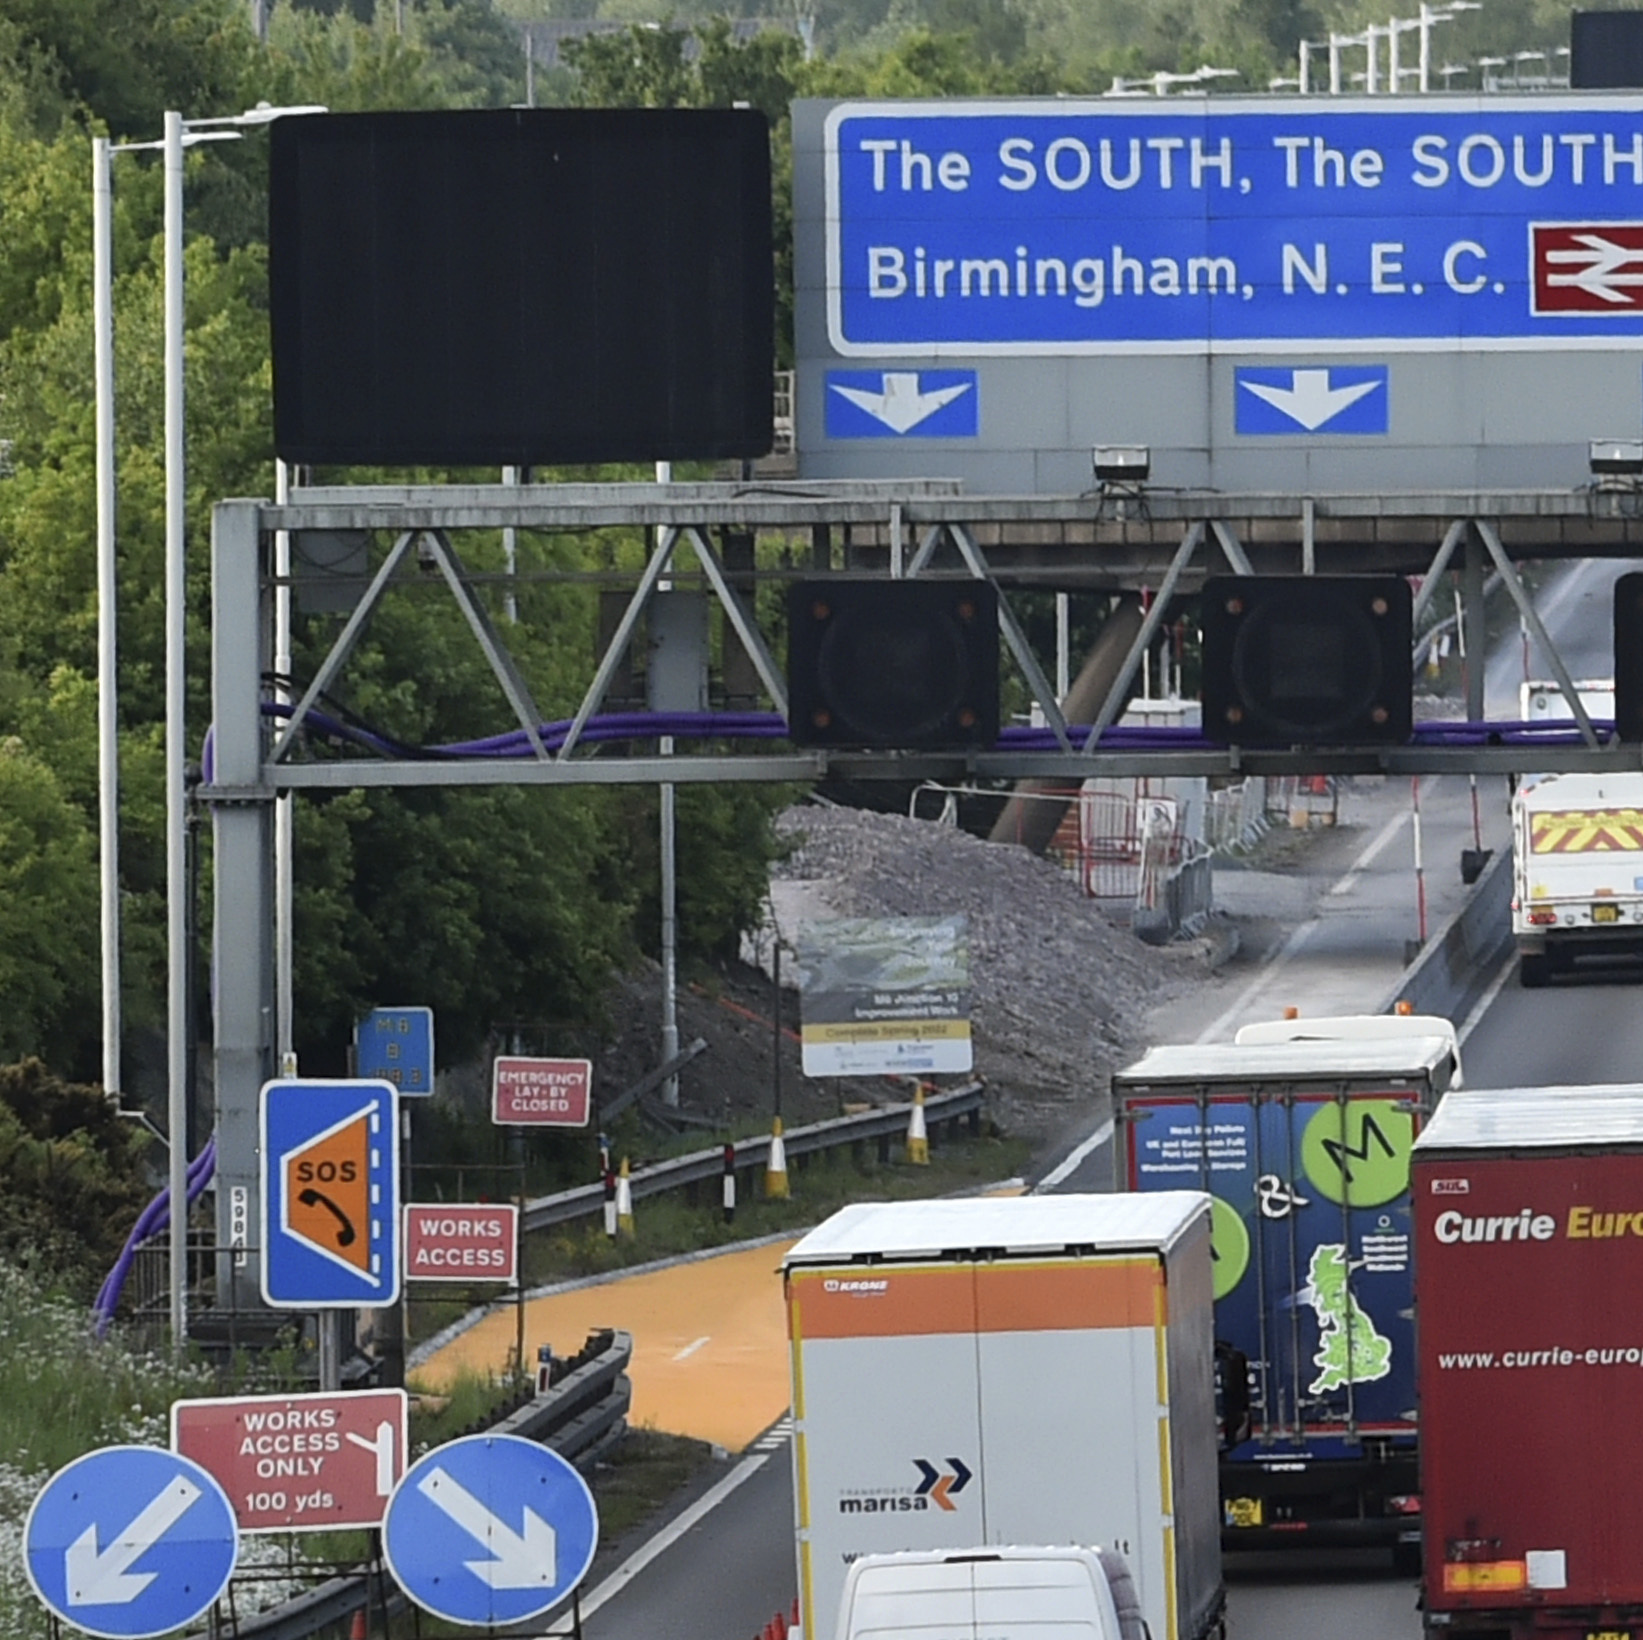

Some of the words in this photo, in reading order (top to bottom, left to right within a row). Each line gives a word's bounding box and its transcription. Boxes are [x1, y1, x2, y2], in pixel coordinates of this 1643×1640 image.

[860, 139, 971, 192] The
[999, 135, 1252, 196] SOUTH,
[1273, 135, 1384, 190] The
[866, 244, 1255, 309] Birmingham,
[499, 1070, 585, 1086] EMERGENCY
[511, 1100, 570, 1113] CLOSED
[296, 1160, 357, 1183] SOS
[419, 1218, 502, 1238] WORKS
[1433, 1207, 1555, 1244] Currie
[415, 1247, 506, 1267] ACCESS
[839, 1280, 889, 1291] KRONE
[244, 1408, 335, 1432] WORKS
[239, 1431, 340, 1455] ACCESS
[256, 1456, 324, 1478] ONLY
[245, 1491, 287, 1512] 100
[295, 1489, 334, 1514] yds
[840, 1497, 928, 1513] marisa
